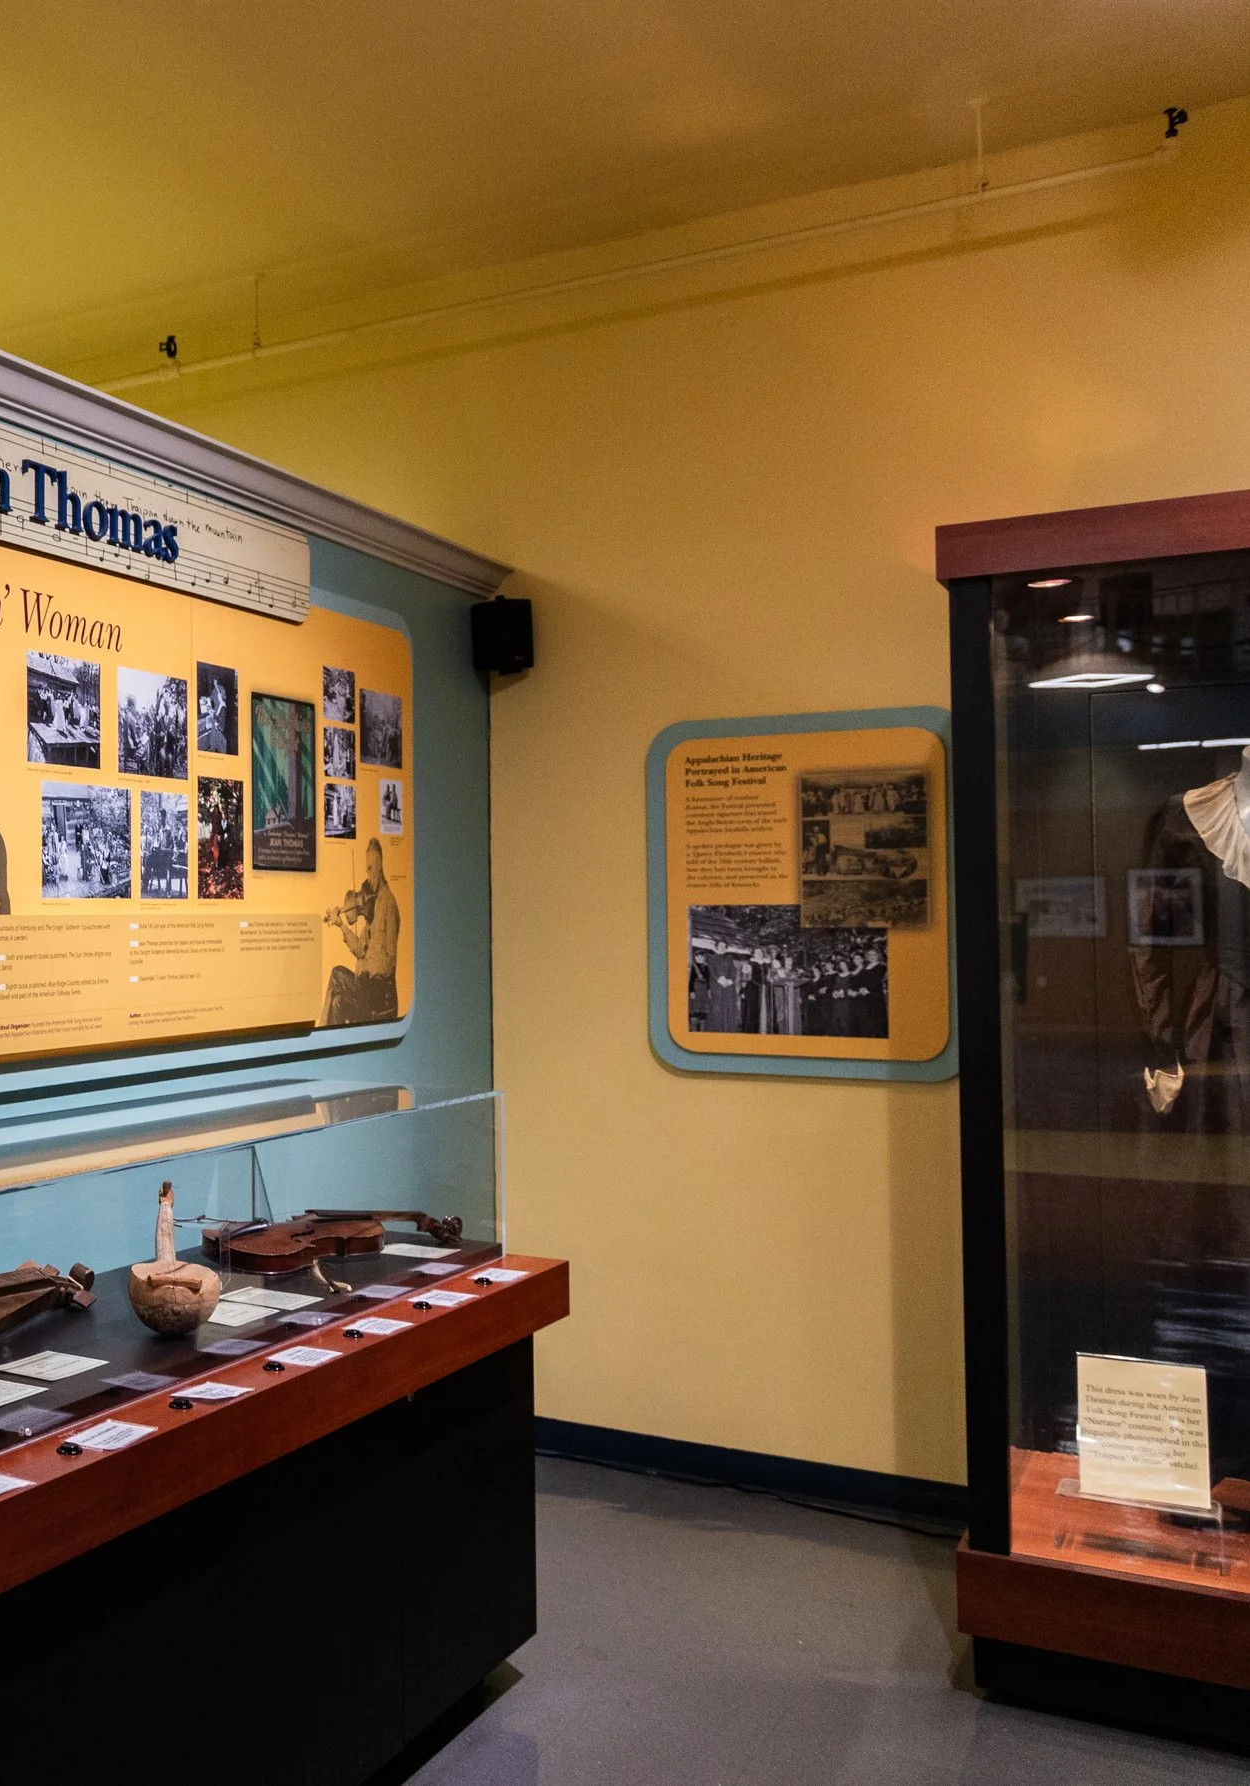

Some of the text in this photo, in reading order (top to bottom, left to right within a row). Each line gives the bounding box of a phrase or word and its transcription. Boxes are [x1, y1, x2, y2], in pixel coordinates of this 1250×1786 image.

[22, 458, 180, 565] Thomas
[205, 523, 243, 543] mountain
[20, 587, 124, 652] Woman
[685, 753, 782, 765] Appalachian Heritage
[685, 765, 787, 776] Portrayed in American
[685, 776, 766, 788] Folk Song Festival
[1086, 1384, 1200, 1403] This dress was worn by Jean
[1085, 1395, 1201, 1414] Thomas during the American
[1086, 1406, 1163, 1421] Folk Song Festival.
